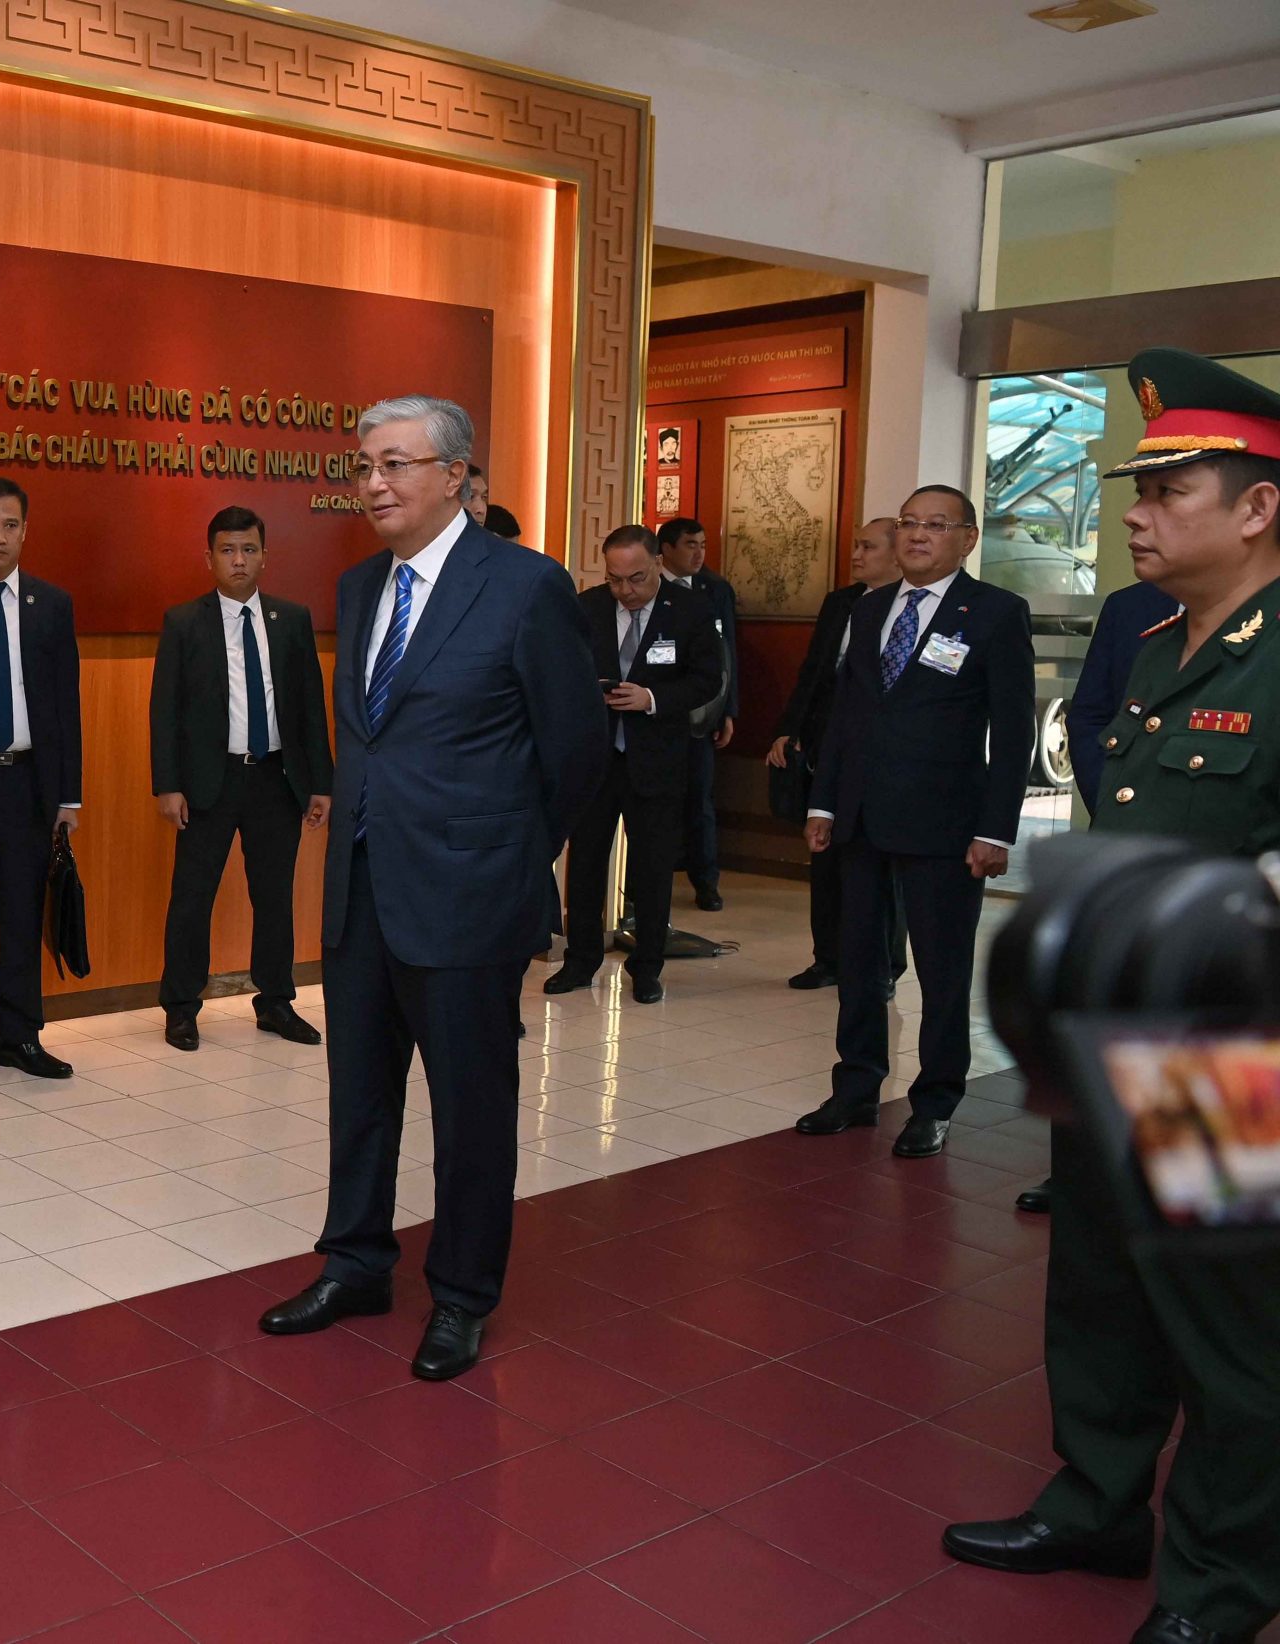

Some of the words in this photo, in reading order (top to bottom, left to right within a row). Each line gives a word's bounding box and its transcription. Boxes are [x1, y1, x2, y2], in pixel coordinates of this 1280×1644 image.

[777, 350, 797, 360] NAM
[70, 379, 119, 410] VUA
[128, 379, 193, 416] HÙNG
[200, 385, 233, 419] ĐÃ
[241, 388, 272, 423] CÓ
[277, 392, 335, 428] CÔNG
[46, 429, 108, 465] CHÁU
[113, 439, 141, 467] TA
[146, 432, 196, 471] PHẢI
[201, 440, 259, 475] CÙNG
[265, 449, 320, 477] NHAU
[310, 493, 329, 510] Lời
[330, 493, 351, 510] Chủ
